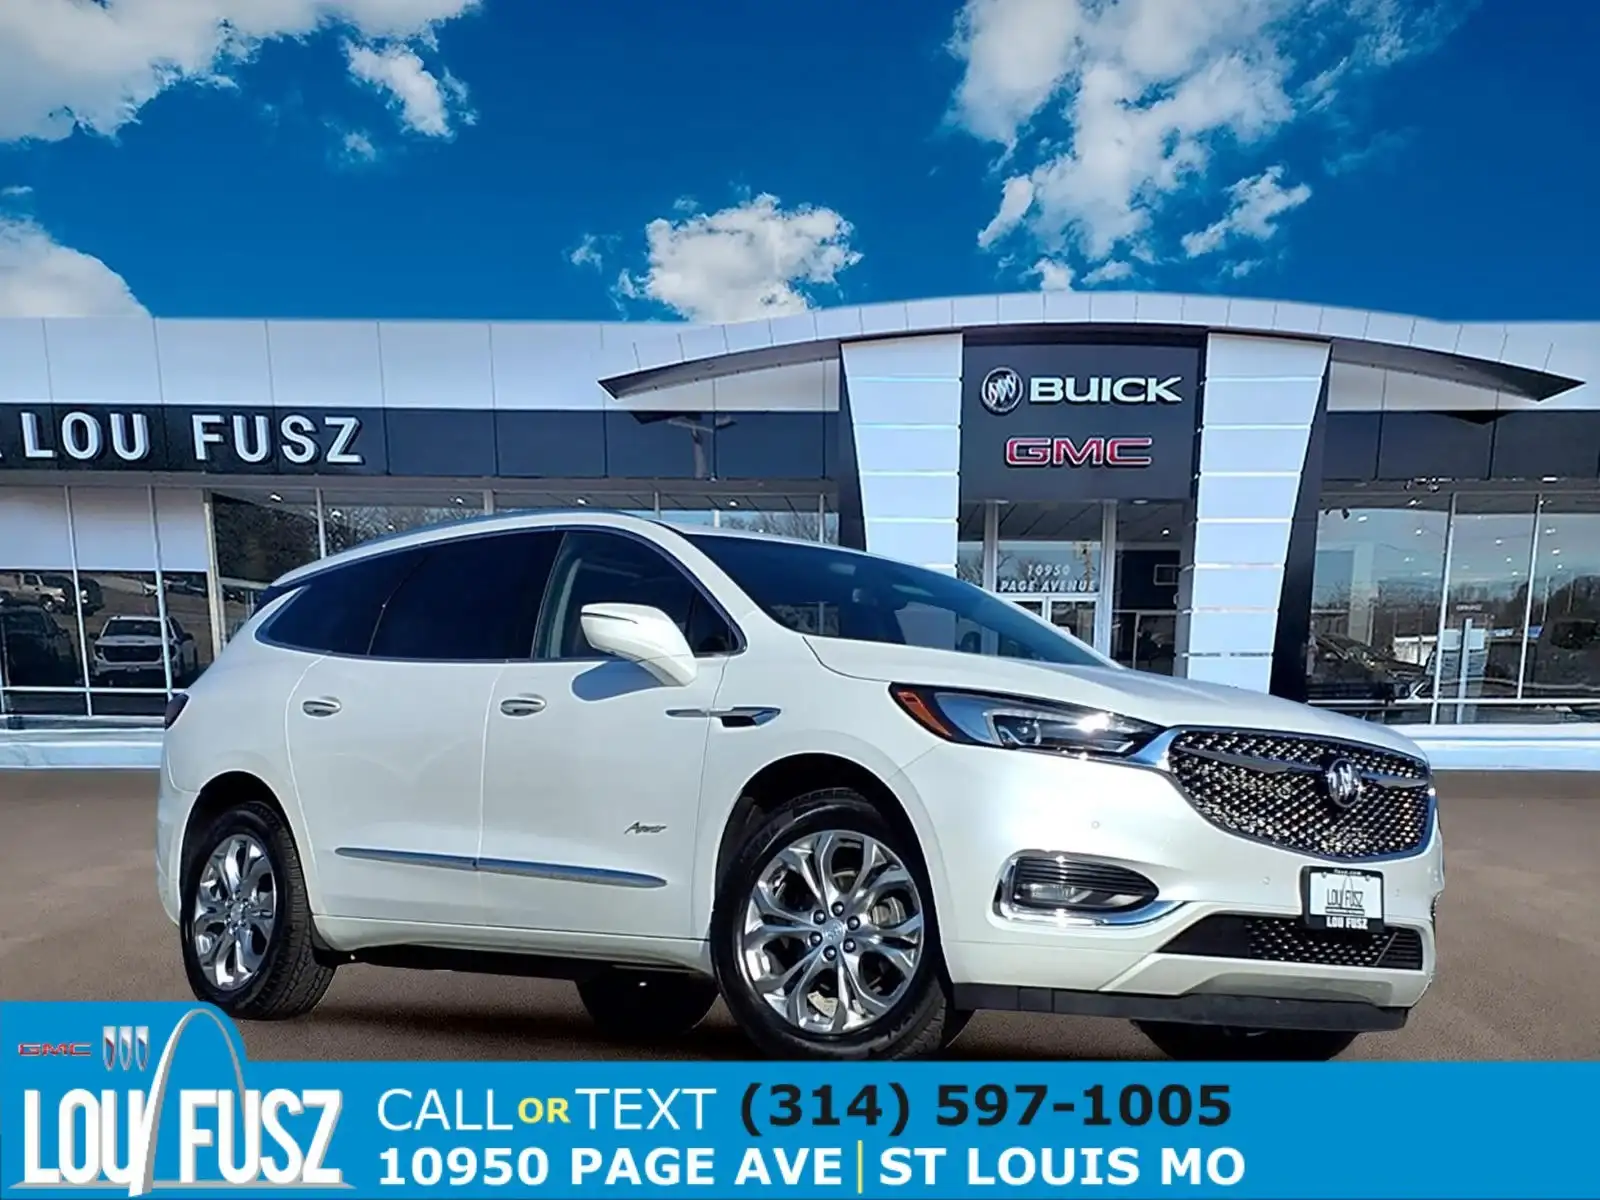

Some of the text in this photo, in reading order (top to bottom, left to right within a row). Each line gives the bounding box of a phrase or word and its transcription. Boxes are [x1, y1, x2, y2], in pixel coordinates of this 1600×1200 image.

[1029, 376, 1183, 402] BUICK
[20, 411, 364, 465] LOU FUSZ
[1006, 437, 1153, 466] GMC
[1026, 563, 1071, 577] 10950
[1000, 579, 1097, 593] PAGE AVENUE
[1326, 916, 1368, 930] LOU FUSZ
